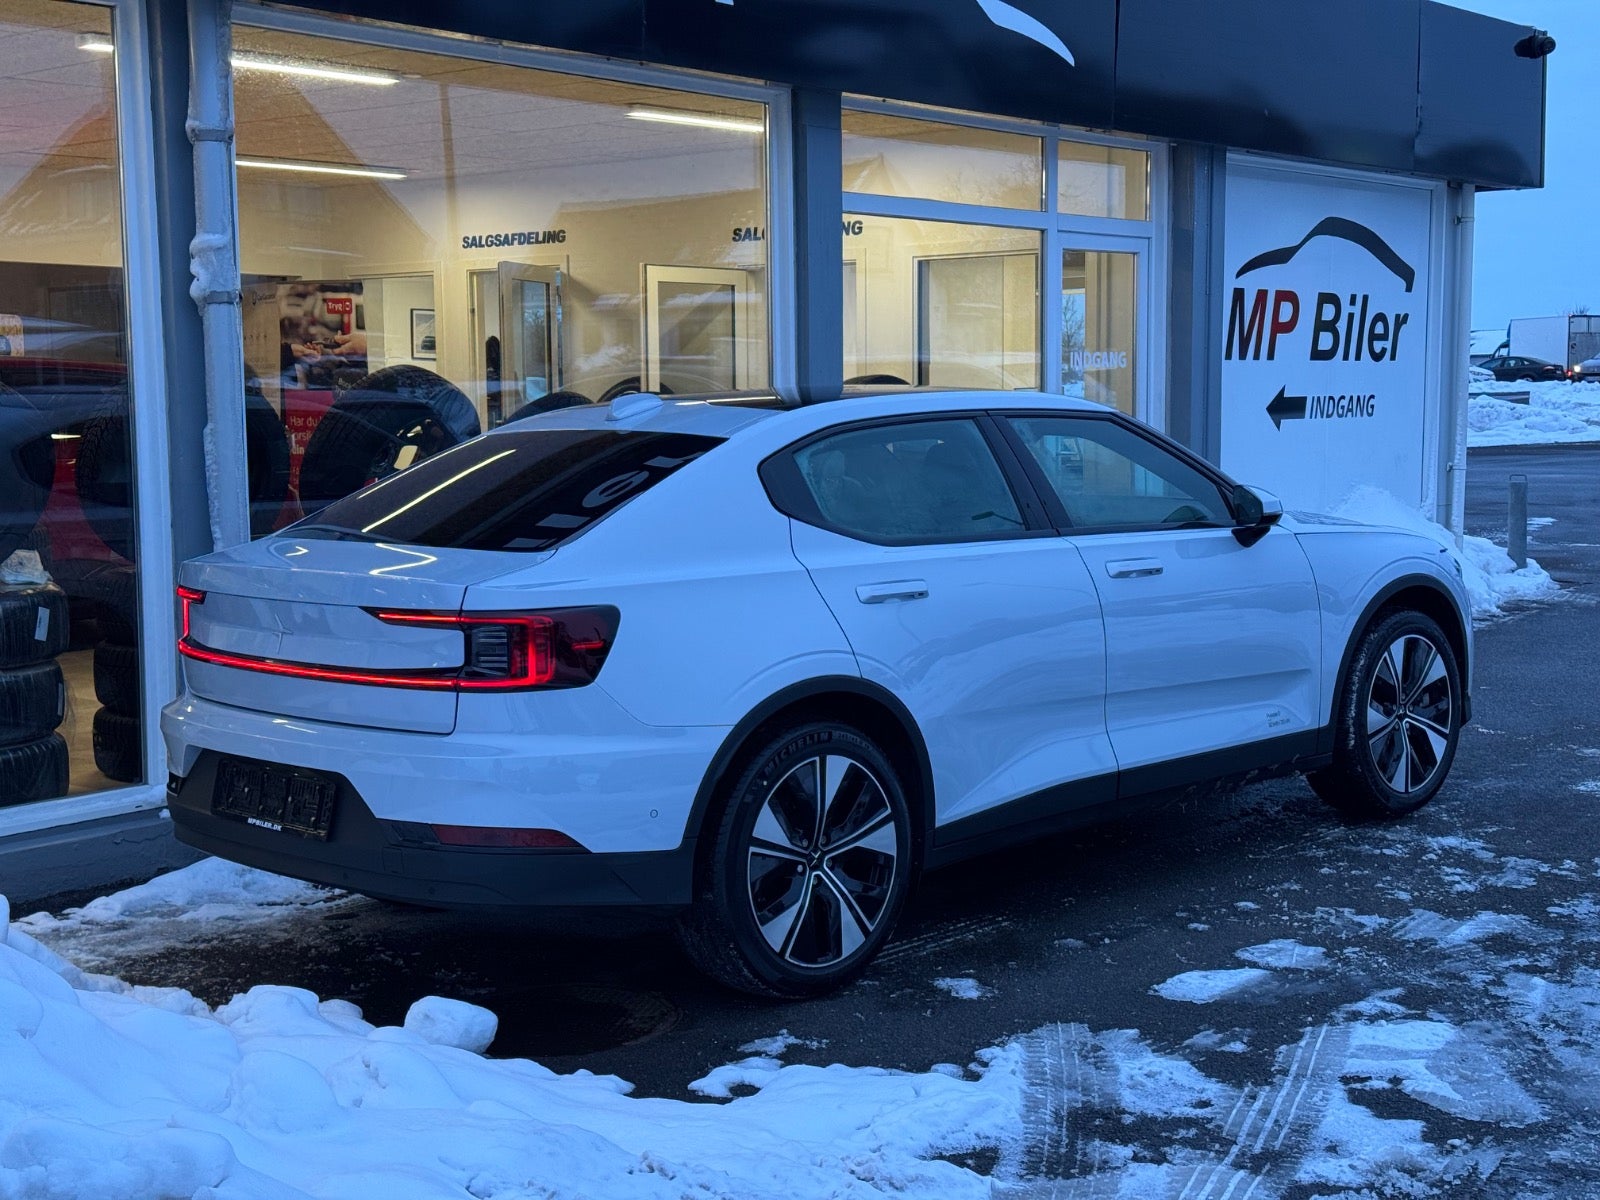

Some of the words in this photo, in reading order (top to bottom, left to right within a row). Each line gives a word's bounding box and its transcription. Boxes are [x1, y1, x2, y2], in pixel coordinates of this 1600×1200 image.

[462, 229, 567, 249] SALGSAFDELING
[732, 226, 765, 242] SAL
[1224, 287, 1300, 361] MP
[1309, 292, 1409, 362] Biler
[1070, 351, 1127, 369] INDGANG
[1309, 394, 1376, 419] INDGANG
[290, 416, 304, 427] Har
[763, 733, 830, 774] MICHELIN
